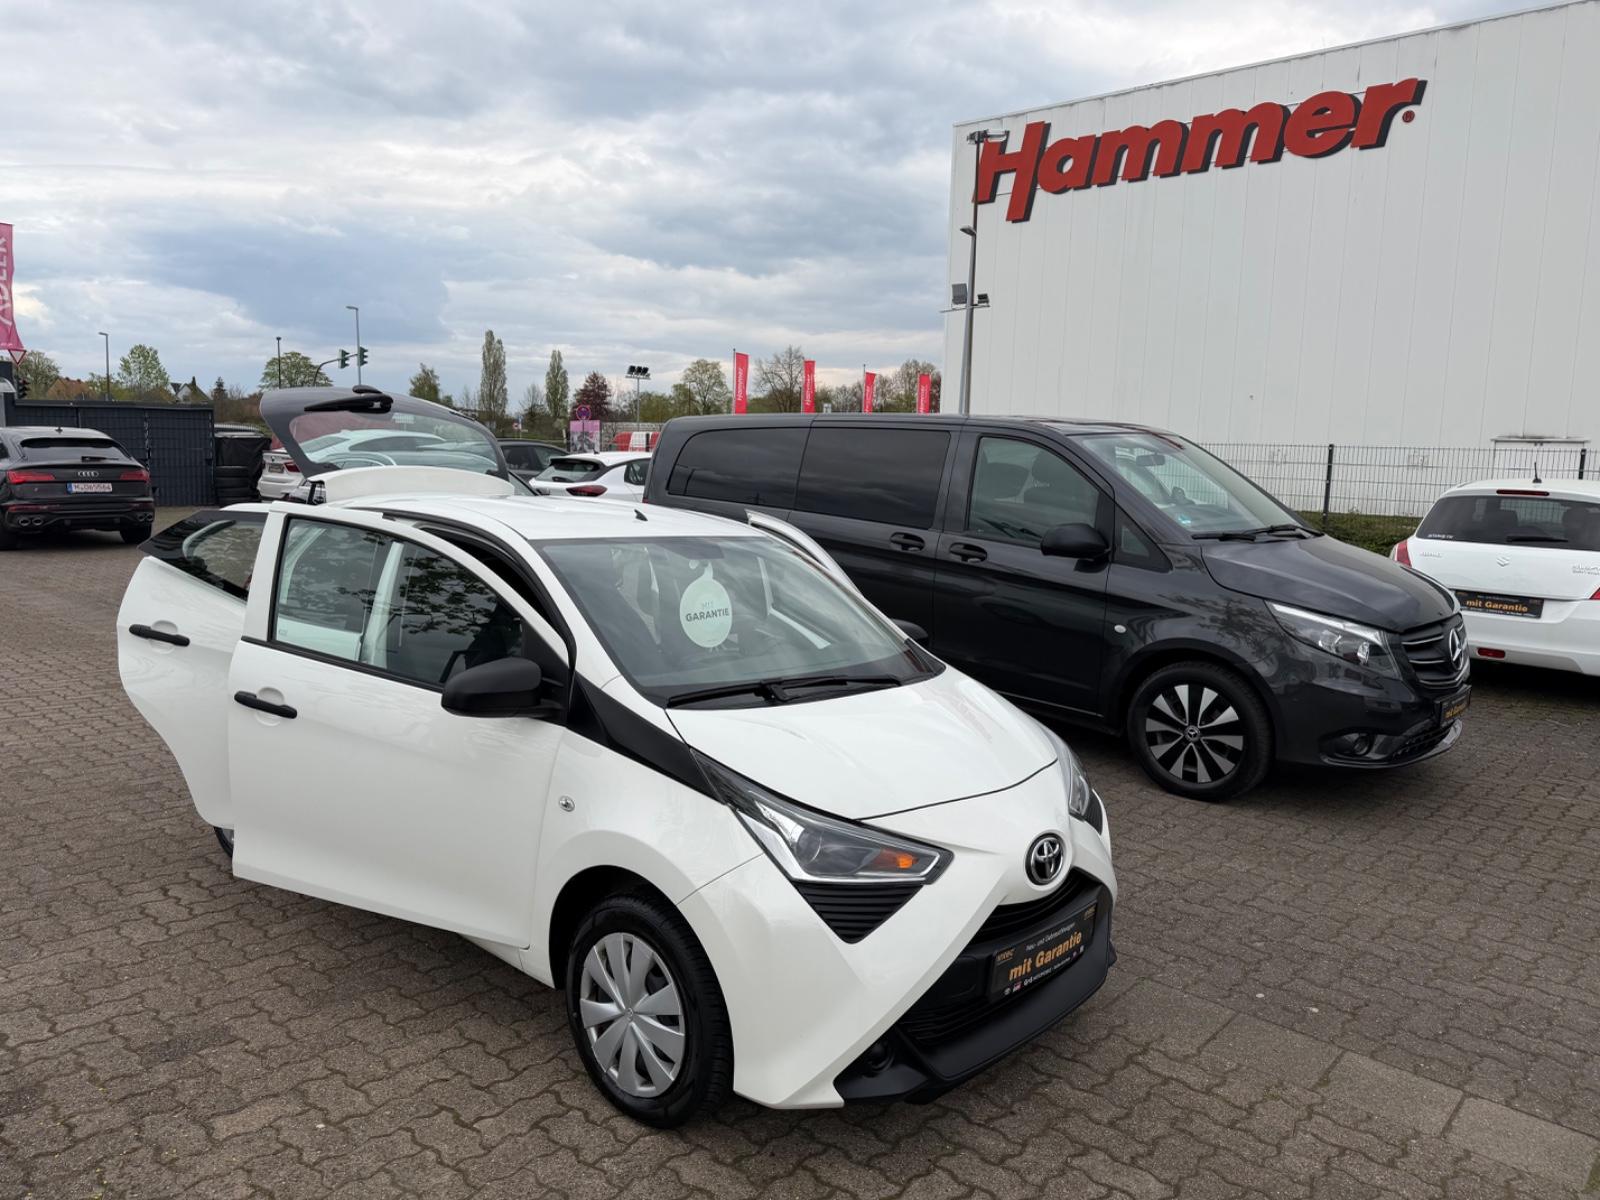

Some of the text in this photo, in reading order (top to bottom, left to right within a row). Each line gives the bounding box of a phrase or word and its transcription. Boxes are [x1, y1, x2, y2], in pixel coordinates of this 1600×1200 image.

[973, 77, 1428, 223] Hammer
[685, 608, 730, 622] GARANTIE
[1466, 599, 1482, 608] mit
[1485, 601, 1528, 613] Garantie
[1007, 957, 1032, 982] mit
[1035, 931, 1082, 968] Garantie
